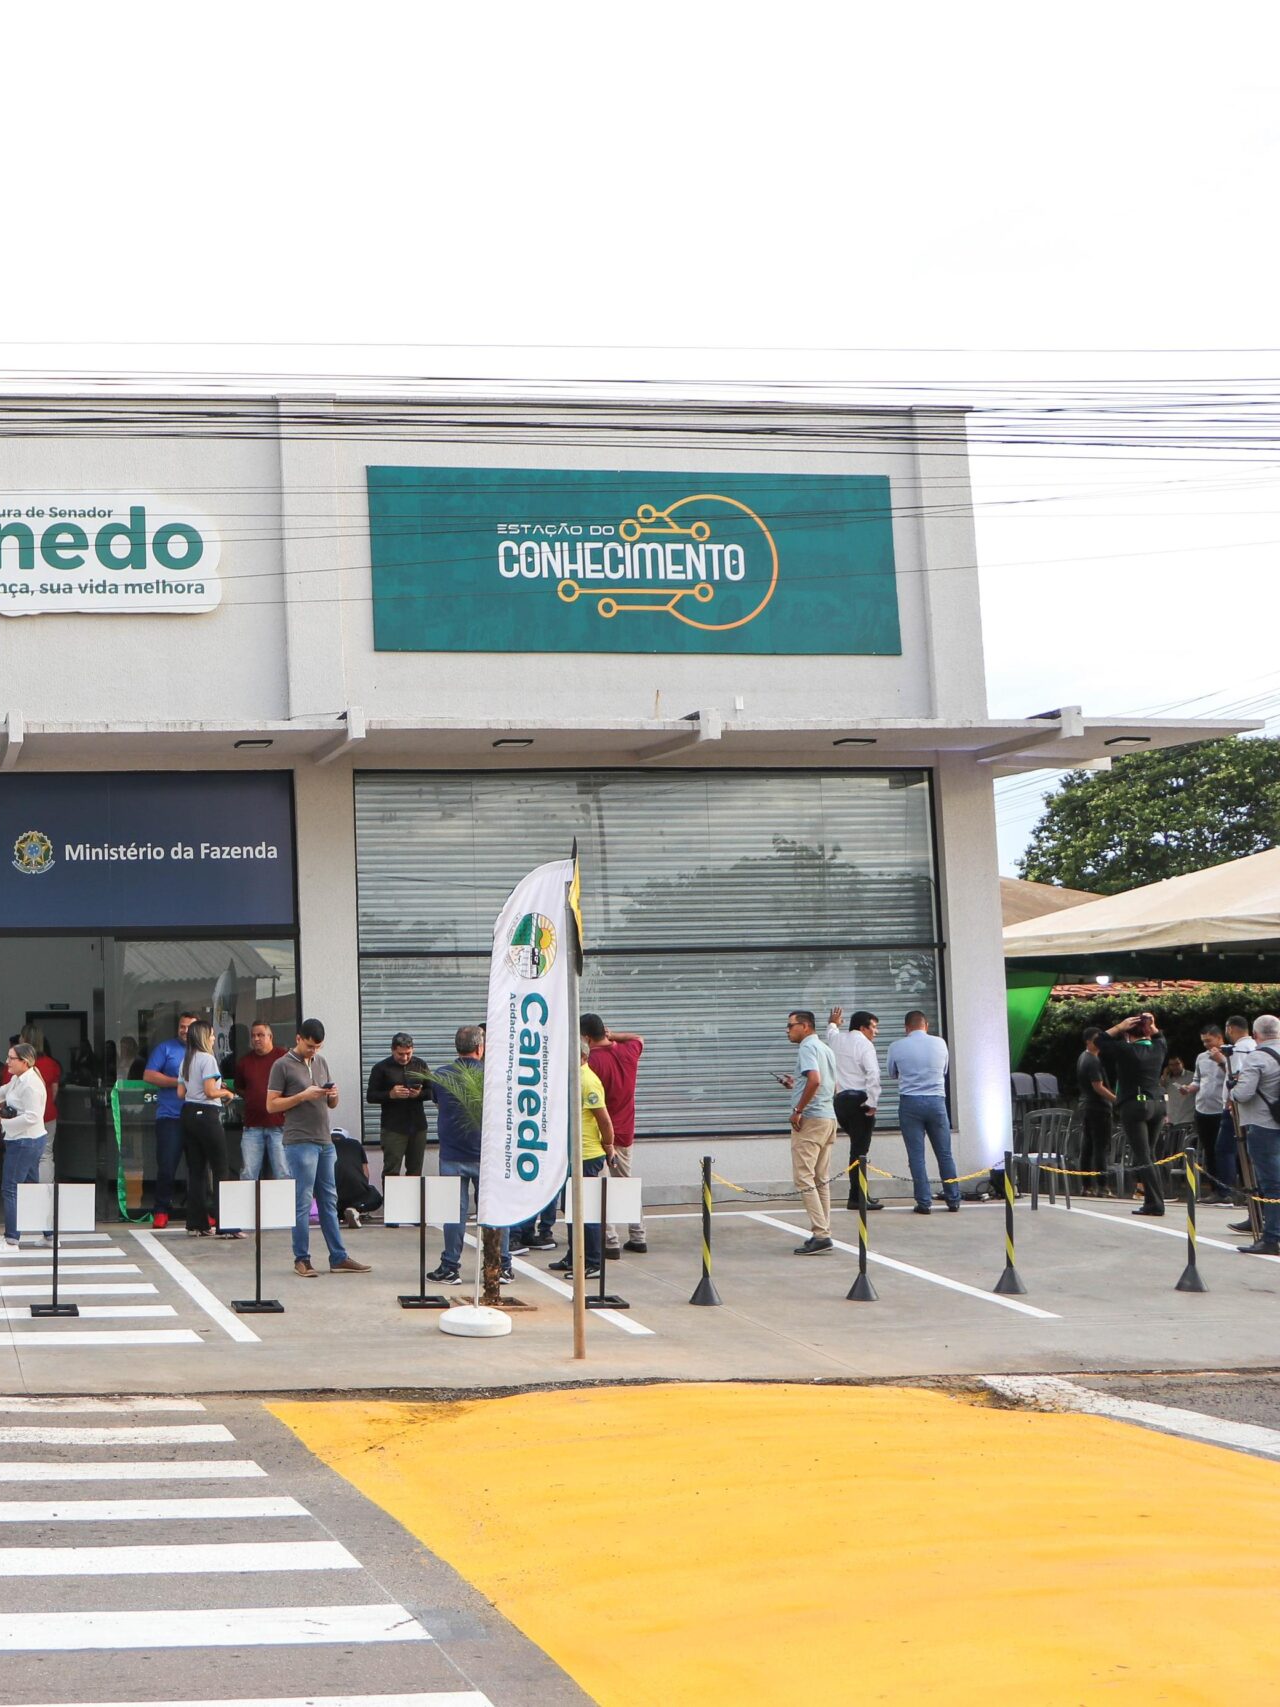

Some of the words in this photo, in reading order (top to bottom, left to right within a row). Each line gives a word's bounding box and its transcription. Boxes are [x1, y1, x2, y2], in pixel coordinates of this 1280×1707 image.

[25, 506, 45, 519] de
[48, 506, 114, 519] Senador
[496, 522, 583, 538] ESTAÇÃO
[589, 525, 615, 536] DO
[497, 539, 746, 581] CONHECIMENTO
[39, 581, 73, 594] sua
[77, 578, 119, 594] vida
[123, 578, 206, 595] melhora
[64, 842, 165, 861] Ministério
[170, 842, 194, 860] da
[200, 842, 278, 860] Fazenda
[509, 992, 517, 1000] A
[509, 1001, 517, 1041] cidade
[516, 992, 549, 1182] Canedo
[542, 1081, 548, 1095] de
[505, 1107, 513, 1131] vida
[504, 1132, 512, 1180] melhora
